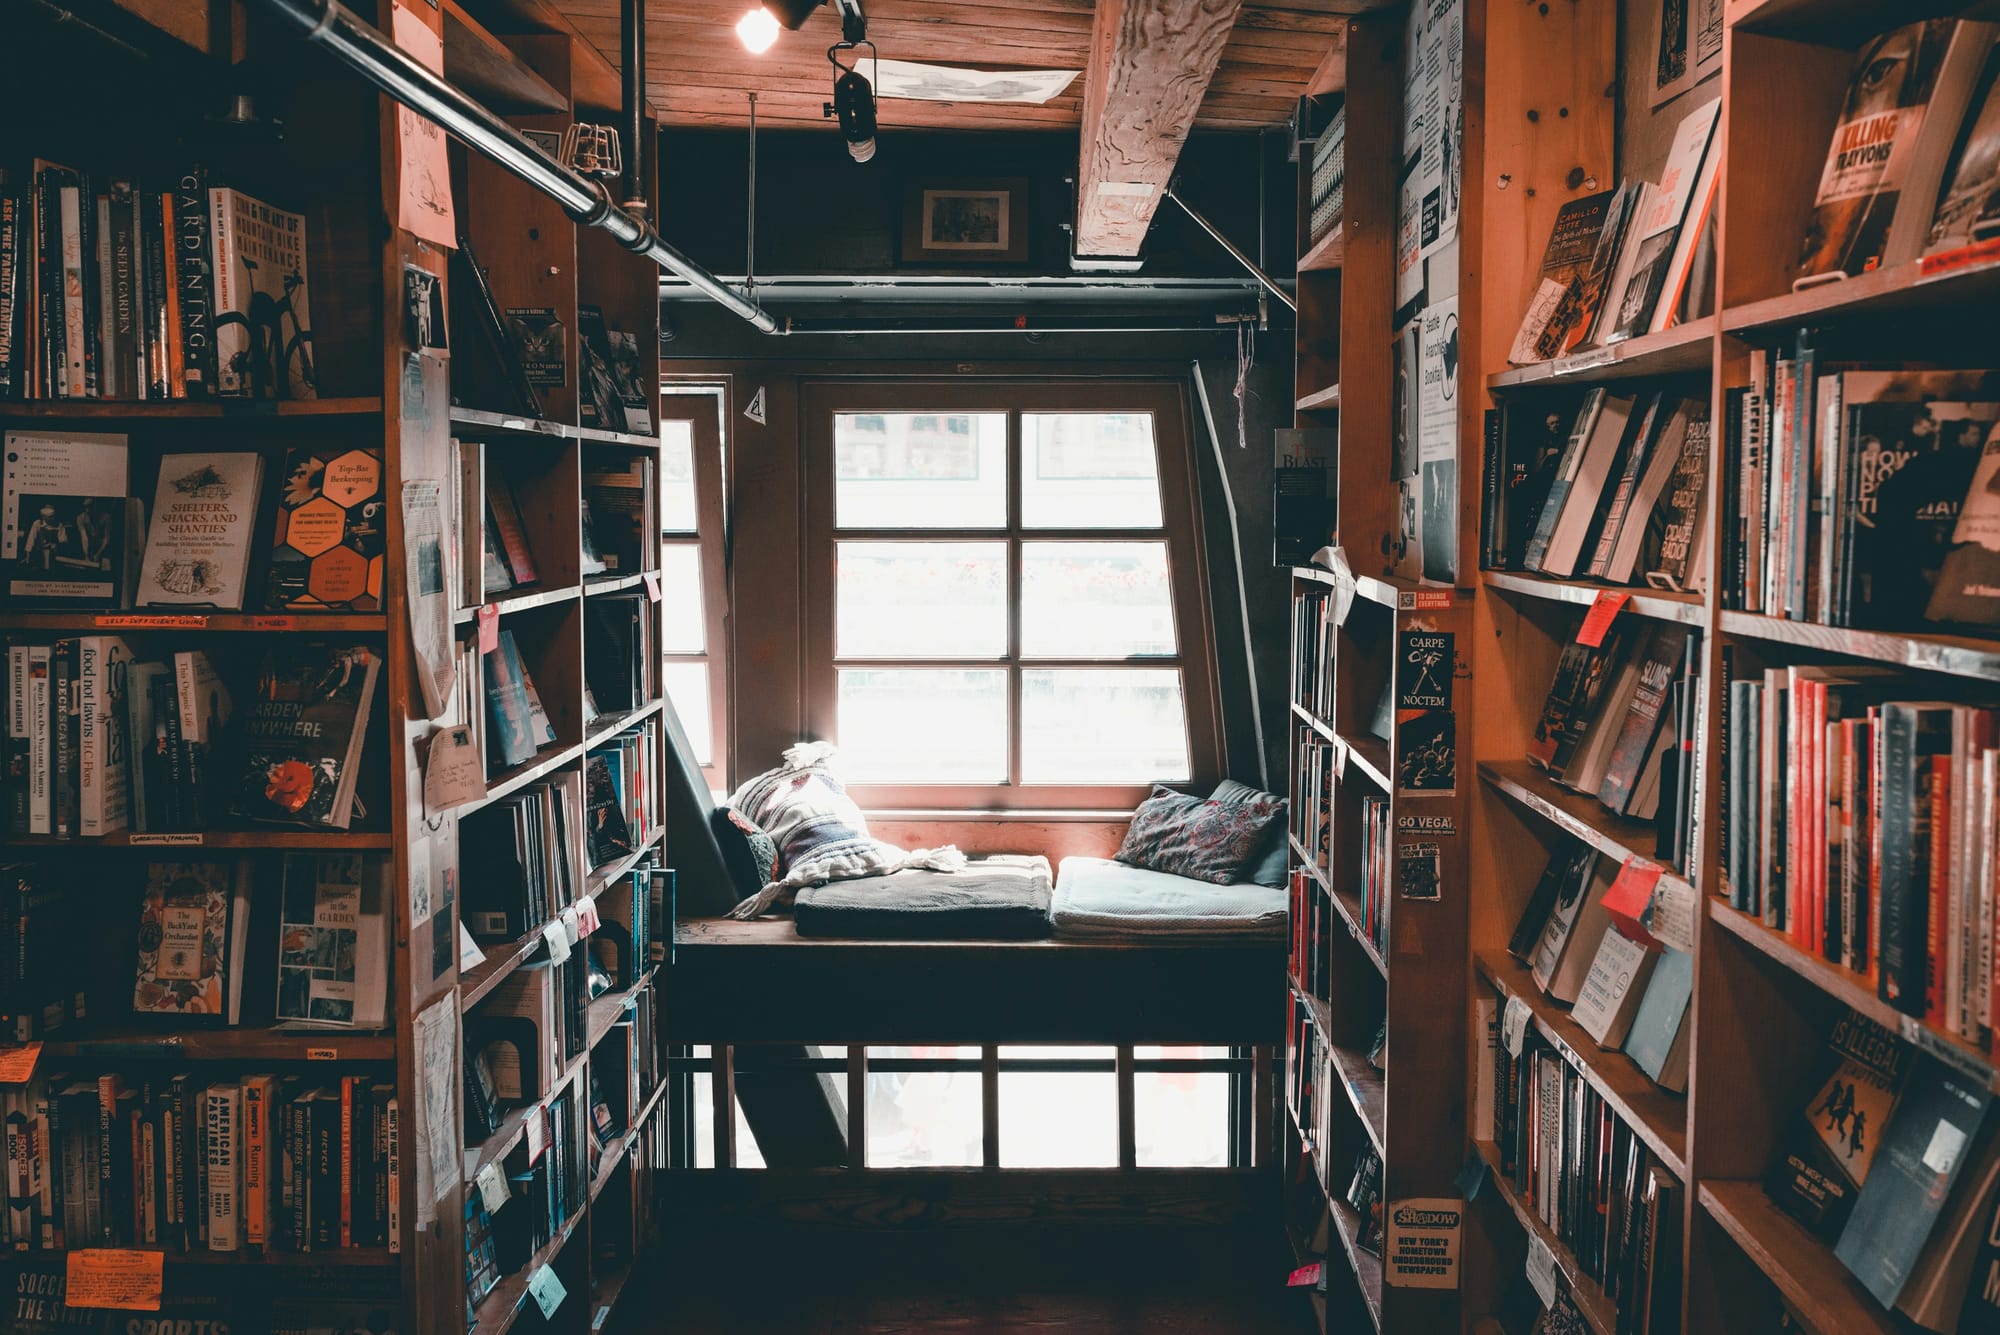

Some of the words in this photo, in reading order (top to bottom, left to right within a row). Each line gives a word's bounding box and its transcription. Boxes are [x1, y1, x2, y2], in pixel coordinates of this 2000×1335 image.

[1840, 114, 1898, 149] KILLING
[1836, 141, 1893, 171] TRAYVONS
[2, 198, 13, 223] ASK
[259, 206, 271, 222] THE
[272, 210, 284, 228] ART
[287, 218, 298, 233] OF
[1560, 207, 1599, 223] CAMILLO
[3, 225, 13, 250] THE
[236, 216, 273, 243] MOUNTAIN
[277, 228, 299, 251] BIKE
[1558, 221, 1581, 232] SITTE
[118, 246, 128, 280] SEED
[181, 175, 205, 348] GARDENING
[237, 236, 300, 270] MAINTENANCE
[1, 252, 12, 304] FAMILY
[119, 281, 130, 335] GARDEN
[0, 306, 10, 363] HANDYMAN
[1687, 422, 1712, 439] RADIC
[1749, 396, 1760, 469] DEFIANT
[338, 465, 369, 474] Top-Bar
[1282, 454, 1329, 468] BLAST
[1513, 463, 1527, 471] THE
[330, 475, 374, 483] Beekeeping
[160, 514, 209, 524] SHACKS,
[210, 513, 238, 523] AND
[170, 503, 230, 513] SHELTERS,
[167, 524, 227, 534] SHANTIES
[1418, 600, 1451, 608] EVERYTHING
[1425, 592, 1447, 600] CHANGE
[1409, 638, 1446, 648] CARPE
[83, 649, 96, 677] food
[179, 662, 188, 680] This
[15, 666, 23, 698] RESILIENT
[83, 678, 93, 699] not
[181, 682, 191, 711] Organic
[1403, 695, 1446, 706] NOCTEM
[16, 700, 24, 733] GARDENER
[83, 701, 96, 738] lawns
[184, 712, 192, 727] Life
[254, 702, 304, 718] ARDEN
[58, 678, 68, 774] DECKSCAPING
[250, 721, 324, 738] NYWHERE
[83, 760, 94, 788] Flores
[1399, 817, 1415, 827] GO
[336, 902, 347, 910] the
[319, 914, 355, 923] GARDEN
[165, 932, 198, 940] Orchardist
[1831, 1019, 1844, 1044] IS
[1844, 1024, 1899, 1074] ILLEGAL
[208, 1096, 219, 1166] PASTIMES
[219, 1096, 231, 1166] AMERICAN
[390, 1132, 398, 1141] MY
[9, 1134, 18, 1161] BOOK
[101, 1133, 110, 1158] TRICKS
[321, 1128, 329, 1177] BICYCLE
[18, 1138, 28, 1176] SOCCER
[248, 1145, 261, 1189] Running
[390, 1159, 398, 1176] FOOL?
[102, 1166, 111, 1180] TIPS
[215, 1193, 223, 1217] OKRENT
[223, 1193, 231, 1216] DANIEL
[1397, 1211, 1457, 1225] SHADOW
[1398, 1238, 1417, 1246] NEW
[1419, 1238, 1449, 1246] YORK'S
[1399, 1247, 1447, 1256] HOMETOWN
[1392, 1256, 1453, 1266] UNDERGROUND
[1397, 1265, 1447, 1275] NEWSPAPER
[17, 1272, 66, 1296] SOCCE
[16, 1298, 43, 1320] THE
